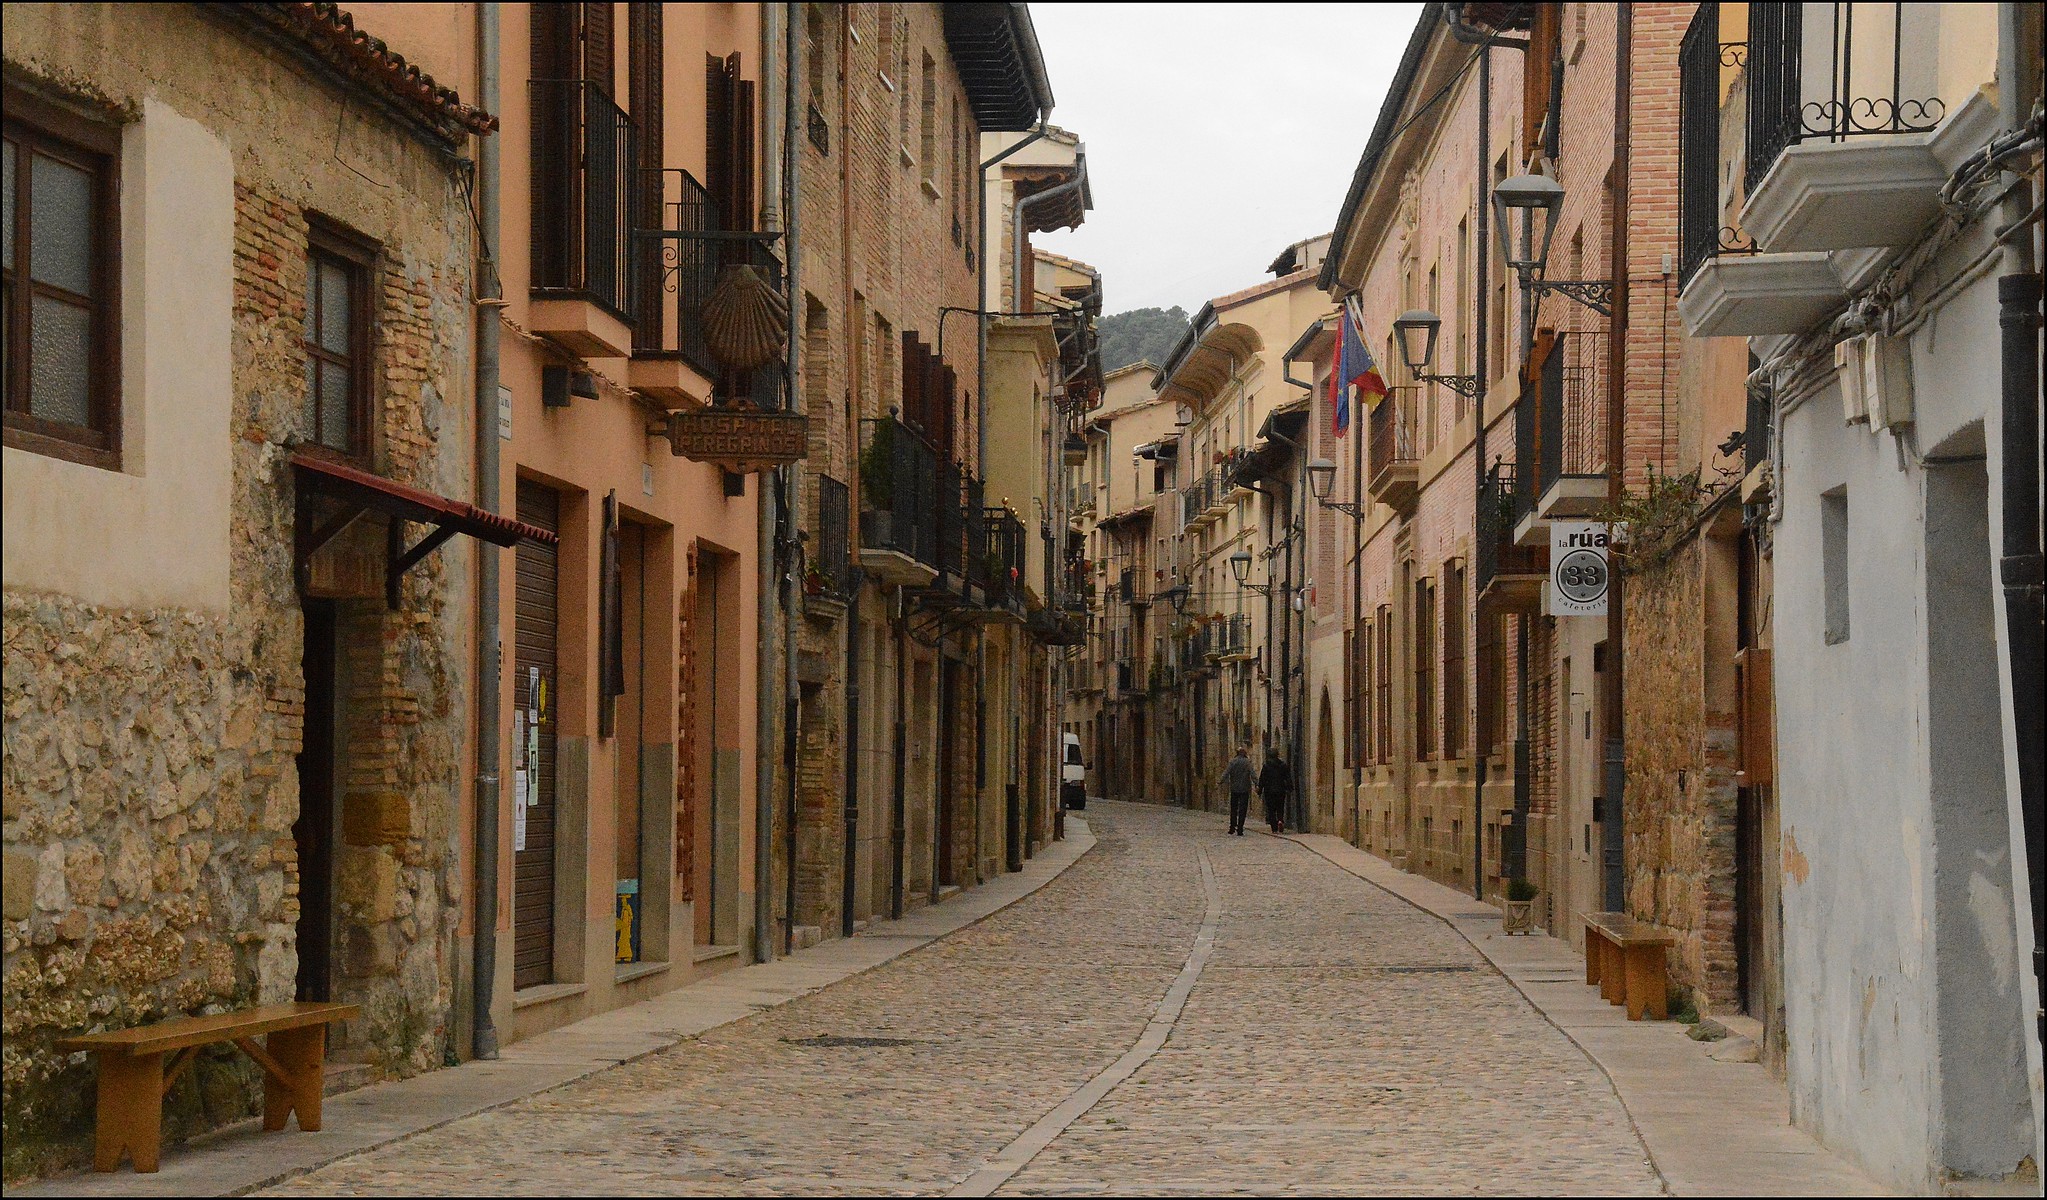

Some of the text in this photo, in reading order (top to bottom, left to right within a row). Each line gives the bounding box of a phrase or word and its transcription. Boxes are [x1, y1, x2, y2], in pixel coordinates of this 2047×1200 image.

[683, 416, 800, 435] HOSPITAL
[1558, 527, 1608, 548] la rúa
[1565, 565, 1600, 587] 33
